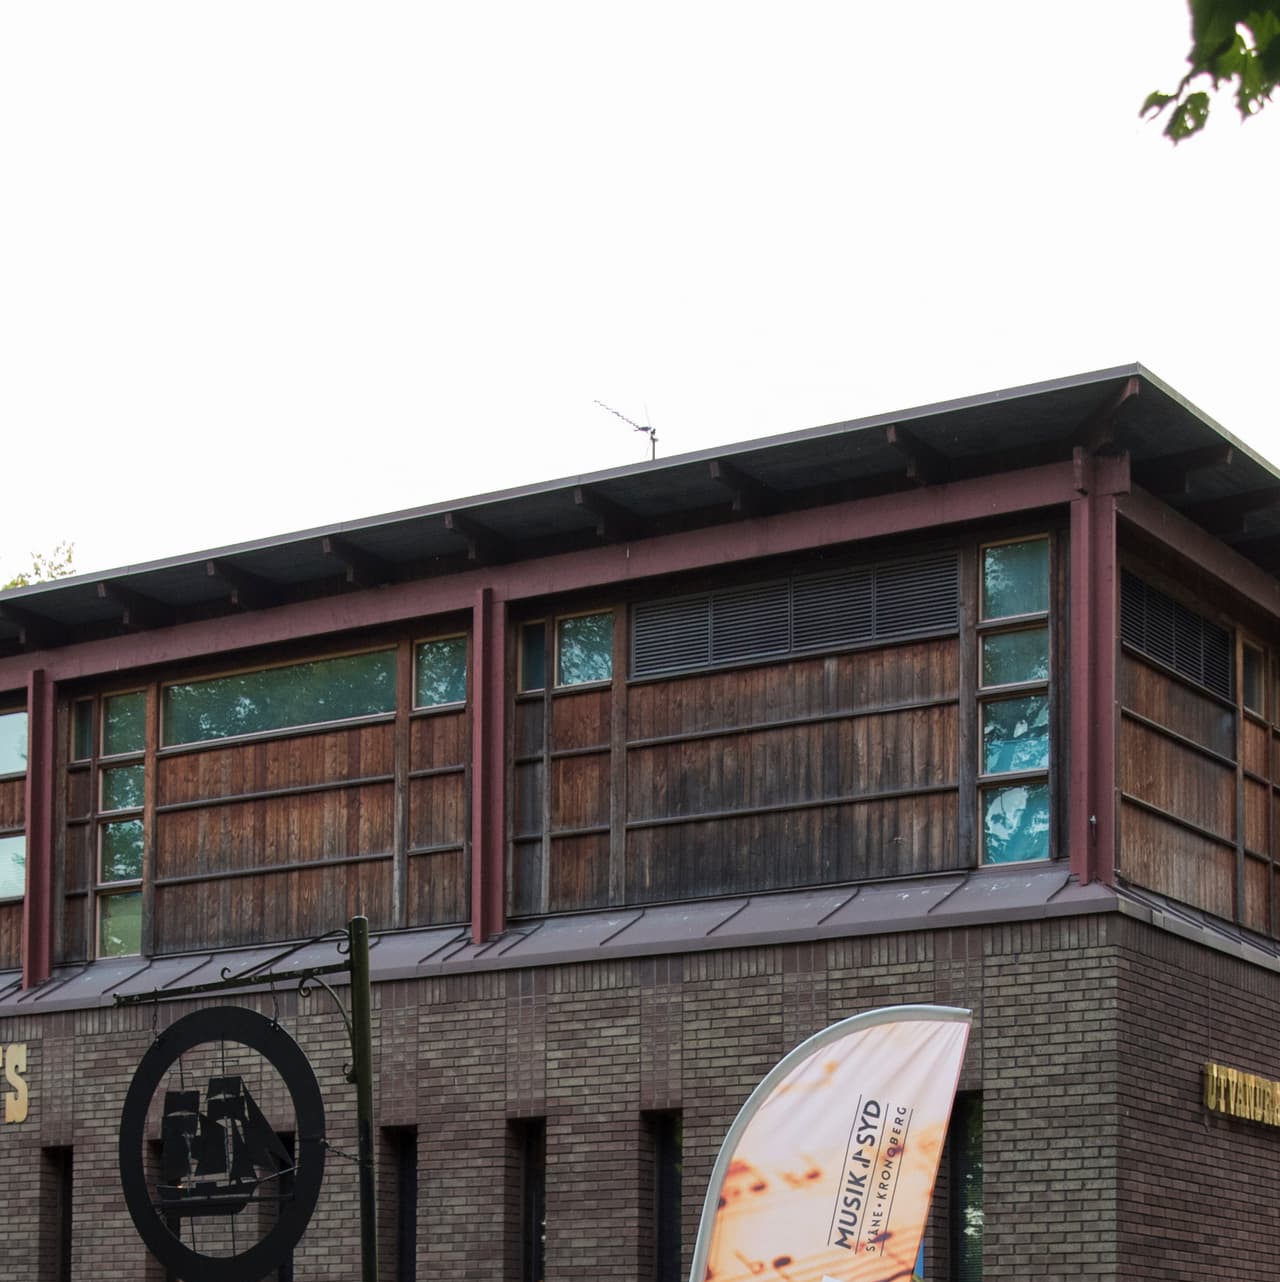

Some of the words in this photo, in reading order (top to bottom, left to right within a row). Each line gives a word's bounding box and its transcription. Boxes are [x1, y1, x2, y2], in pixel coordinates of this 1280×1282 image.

[834, 1170, 868, 1250] MUSIK
[856, 1099, 881, 1147] SYD
[865, 1210, 883, 1252] SKÅNE
[876, 1106, 907, 1200] KRONOBERG
